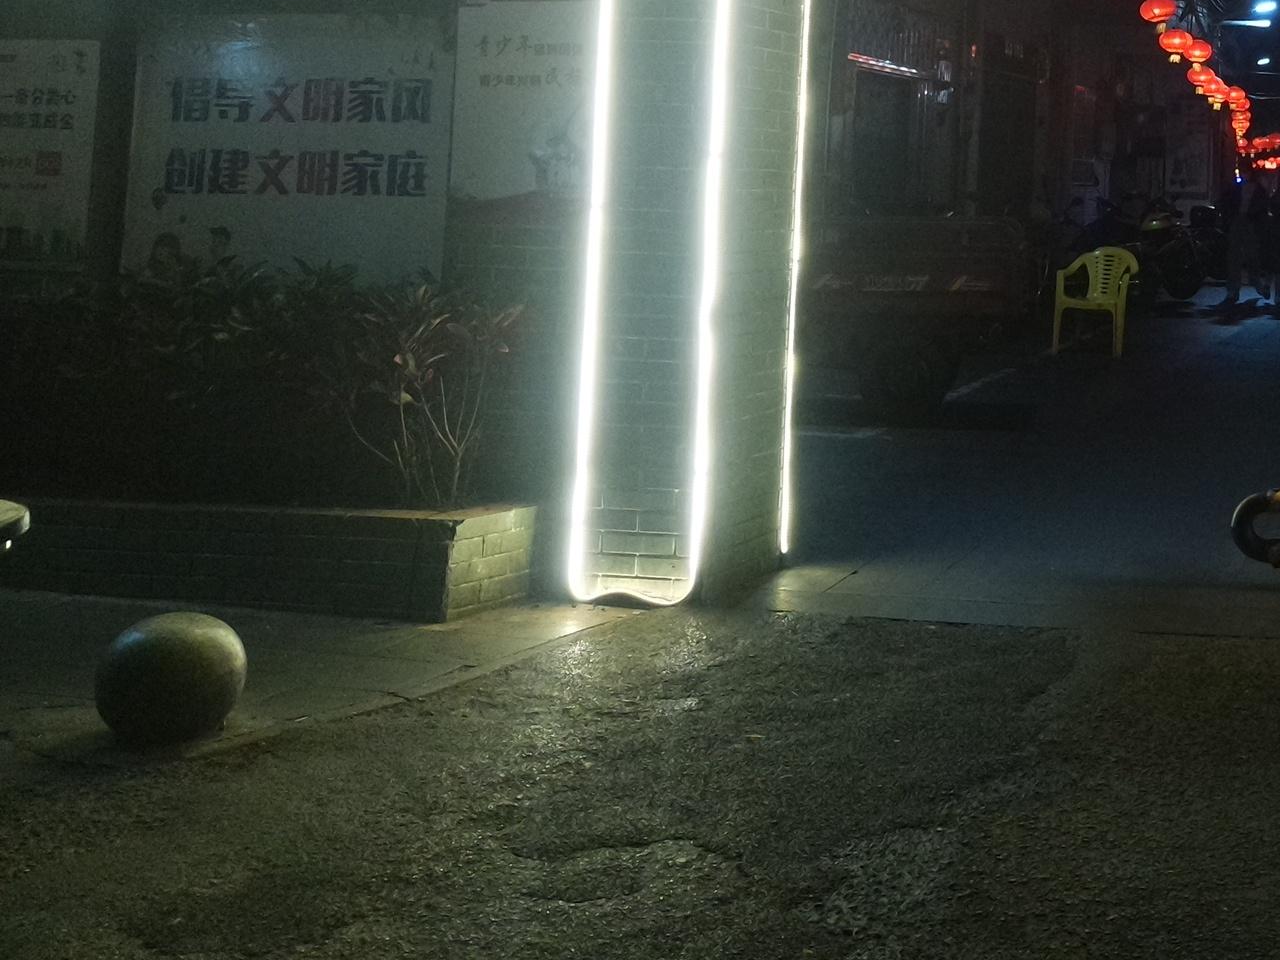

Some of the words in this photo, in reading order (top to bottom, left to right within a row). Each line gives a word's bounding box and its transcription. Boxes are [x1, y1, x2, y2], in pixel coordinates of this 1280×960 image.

[167, 76, 432, 123] 倡导文明家风
[164, 148, 428, 197] 创建文明家庭
